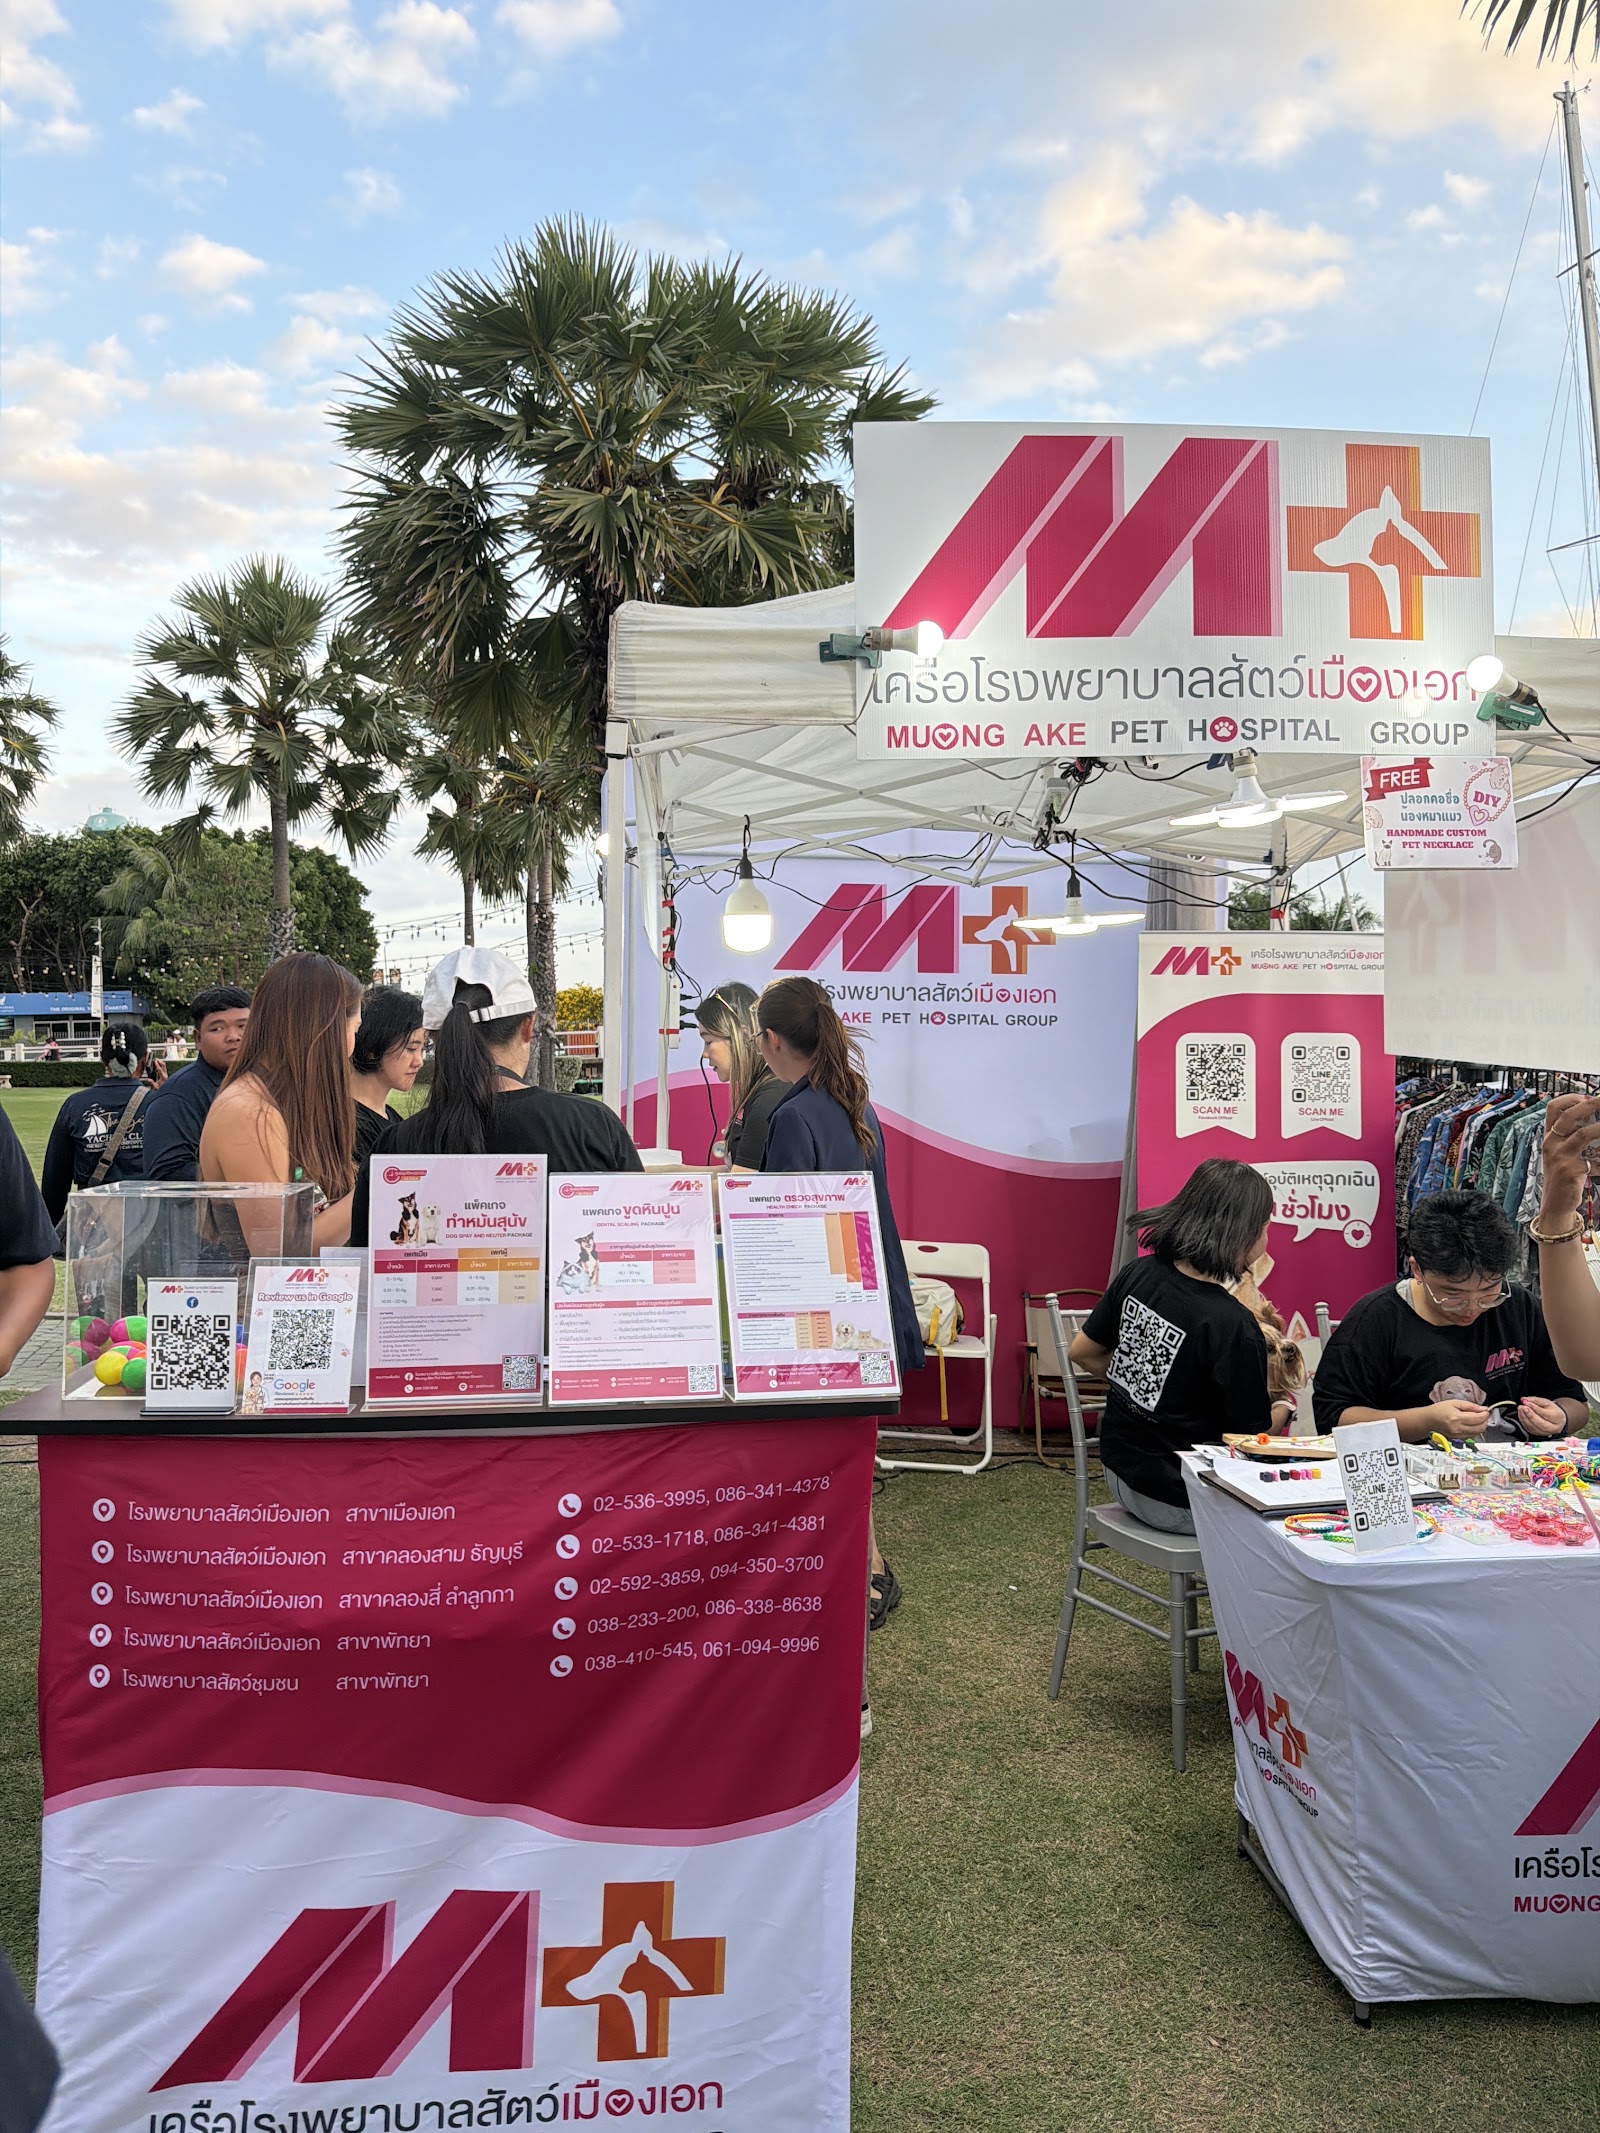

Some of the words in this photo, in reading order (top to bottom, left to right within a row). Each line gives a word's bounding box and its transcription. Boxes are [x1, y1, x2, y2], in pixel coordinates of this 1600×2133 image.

[887, 722, 1005, 750] MUONG
[1024, 722, 1087, 746] AKE
[1111, 719, 1169, 744] PET
[1188, 716, 1340, 743] HOSPITAL
[1370, 721, 1470, 746] GROUP
[1380, 768, 1421, 789] FREE
[1400, 789, 1460, 805] ปลอกคอชื่อ
[1472, 790, 1502, 808] DIY
[1400, 805, 1462, 822] น้องหมาแมว
[1386, 829, 1444, 837] HANDMADE
[1446, 829, 1487, 837] CUSTOM
[1402, 841, 1420, 849] PET
[1423, 841, 1474, 849] NECKLACE
[1320, 963, 1359, 971] HOSPITAL
[841, 1012, 872, 1024] AKE
[882, 1012, 911, 1024] PET
[919, 1011, 999, 1026] HOSPITAL
[1005, 1014, 1058, 1027] GROUP
[1311, 1071, 1331, 1079] LINE
[1192, 1106, 1221, 1114] SCAN
[1223, 1106, 1238, 1114] ME
[1298, 1107, 1327, 1115] SCAN
[1329, 1108, 1344, 1116] ME
[87, 1134, 112, 1144] YACH
[129, 1132, 143, 1140] CL
[784, 1193, 845, 1204] ตรวจสุขภาพ
[1282, 1188, 1351, 1221] ชั่วโมง
[582, 1207, 622, 1216] แพคเกจ
[623, 1202, 680, 1219] ขูดหินปูน
[446, 1213, 527, 1232] ทำหมันสุนัข
[258, 1292, 294, 1301] Review
[295, 1293, 306, 1301] us
[308, 1292, 317, 1301] in
[319, 1292, 353, 1303] Google
[274, 1379, 315, 1392] Google
[593, 1488, 711, 1512] 02-536-3995,
[715, 1475, 830, 1503] 086-341-4378
[1368, 1483, 1386, 1495] LINE
[128, 1502, 330, 1523] โรงพยาบาลสัตว์เมืองเอก
[345, 1503, 455, 1523] สาขาเมืองเอก
[591, 1529, 709, 1555] 02-533-1718,
[713, 1515, 826, 1543] 086-341-4381
[126, 1543, 326, 1566] โรงพยาบาลสัตว์เมืองเอก
[342, 1547, 465, 1567] สาขาคลองสาม
[471, 1540, 523, 1566] ธัญบุรี
[589, 1568, 705, 1596] 02-592-3859,
[710, 1554, 824, 1580] 094-350-3700
[125, 1585, 323, 1609] โรงพยาบาลสัตว์เมืองเอก
[339, 1582, 441, 1608] สาขาคลองสี่
[446, 1585, 515, 1611] ลำลูกกา
[587, 1604, 700, 1635] 038-233-200,
[704, 1596, 822, 1615] 086-338-8638
[123, 1626, 321, 1651] โรงพยาบาลสัตว์เมืองเอก
[337, 1631, 431, 1651] สาขาพัทยา
[584, 1640, 697, 1672] 038-410-545,
[702, 1636, 820, 1658] 061-094-9996
[122, 1668, 299, 1696] โรงพยาบาลสัตว์ชุมชน
[336, 1670, 429, 1691] สาขาพัทยา
[150, 2079, 723, 2133] เครือโรงพยาบาลสัตว์เมืองเอก
